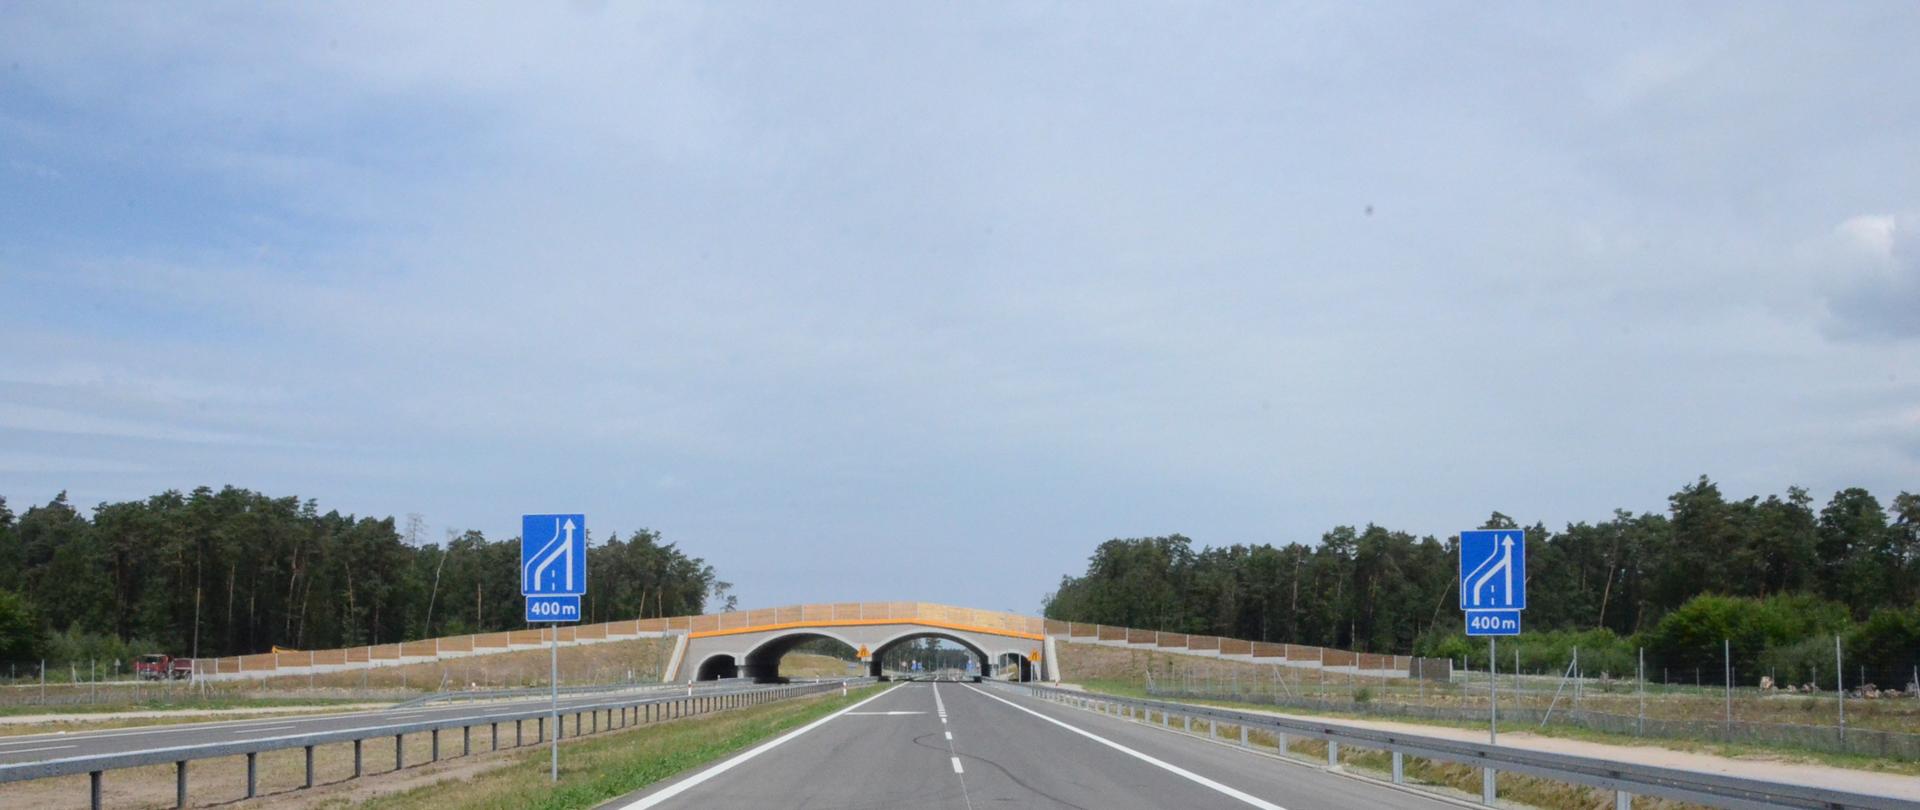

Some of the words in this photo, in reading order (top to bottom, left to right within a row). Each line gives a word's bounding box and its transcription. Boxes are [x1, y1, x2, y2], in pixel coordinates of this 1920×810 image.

[531, 602, 560, 615] 400
[562, 604, 576, 615] m
[1471, 616, 1500, 629] 400
[1502, 619, 1515, 629] m
